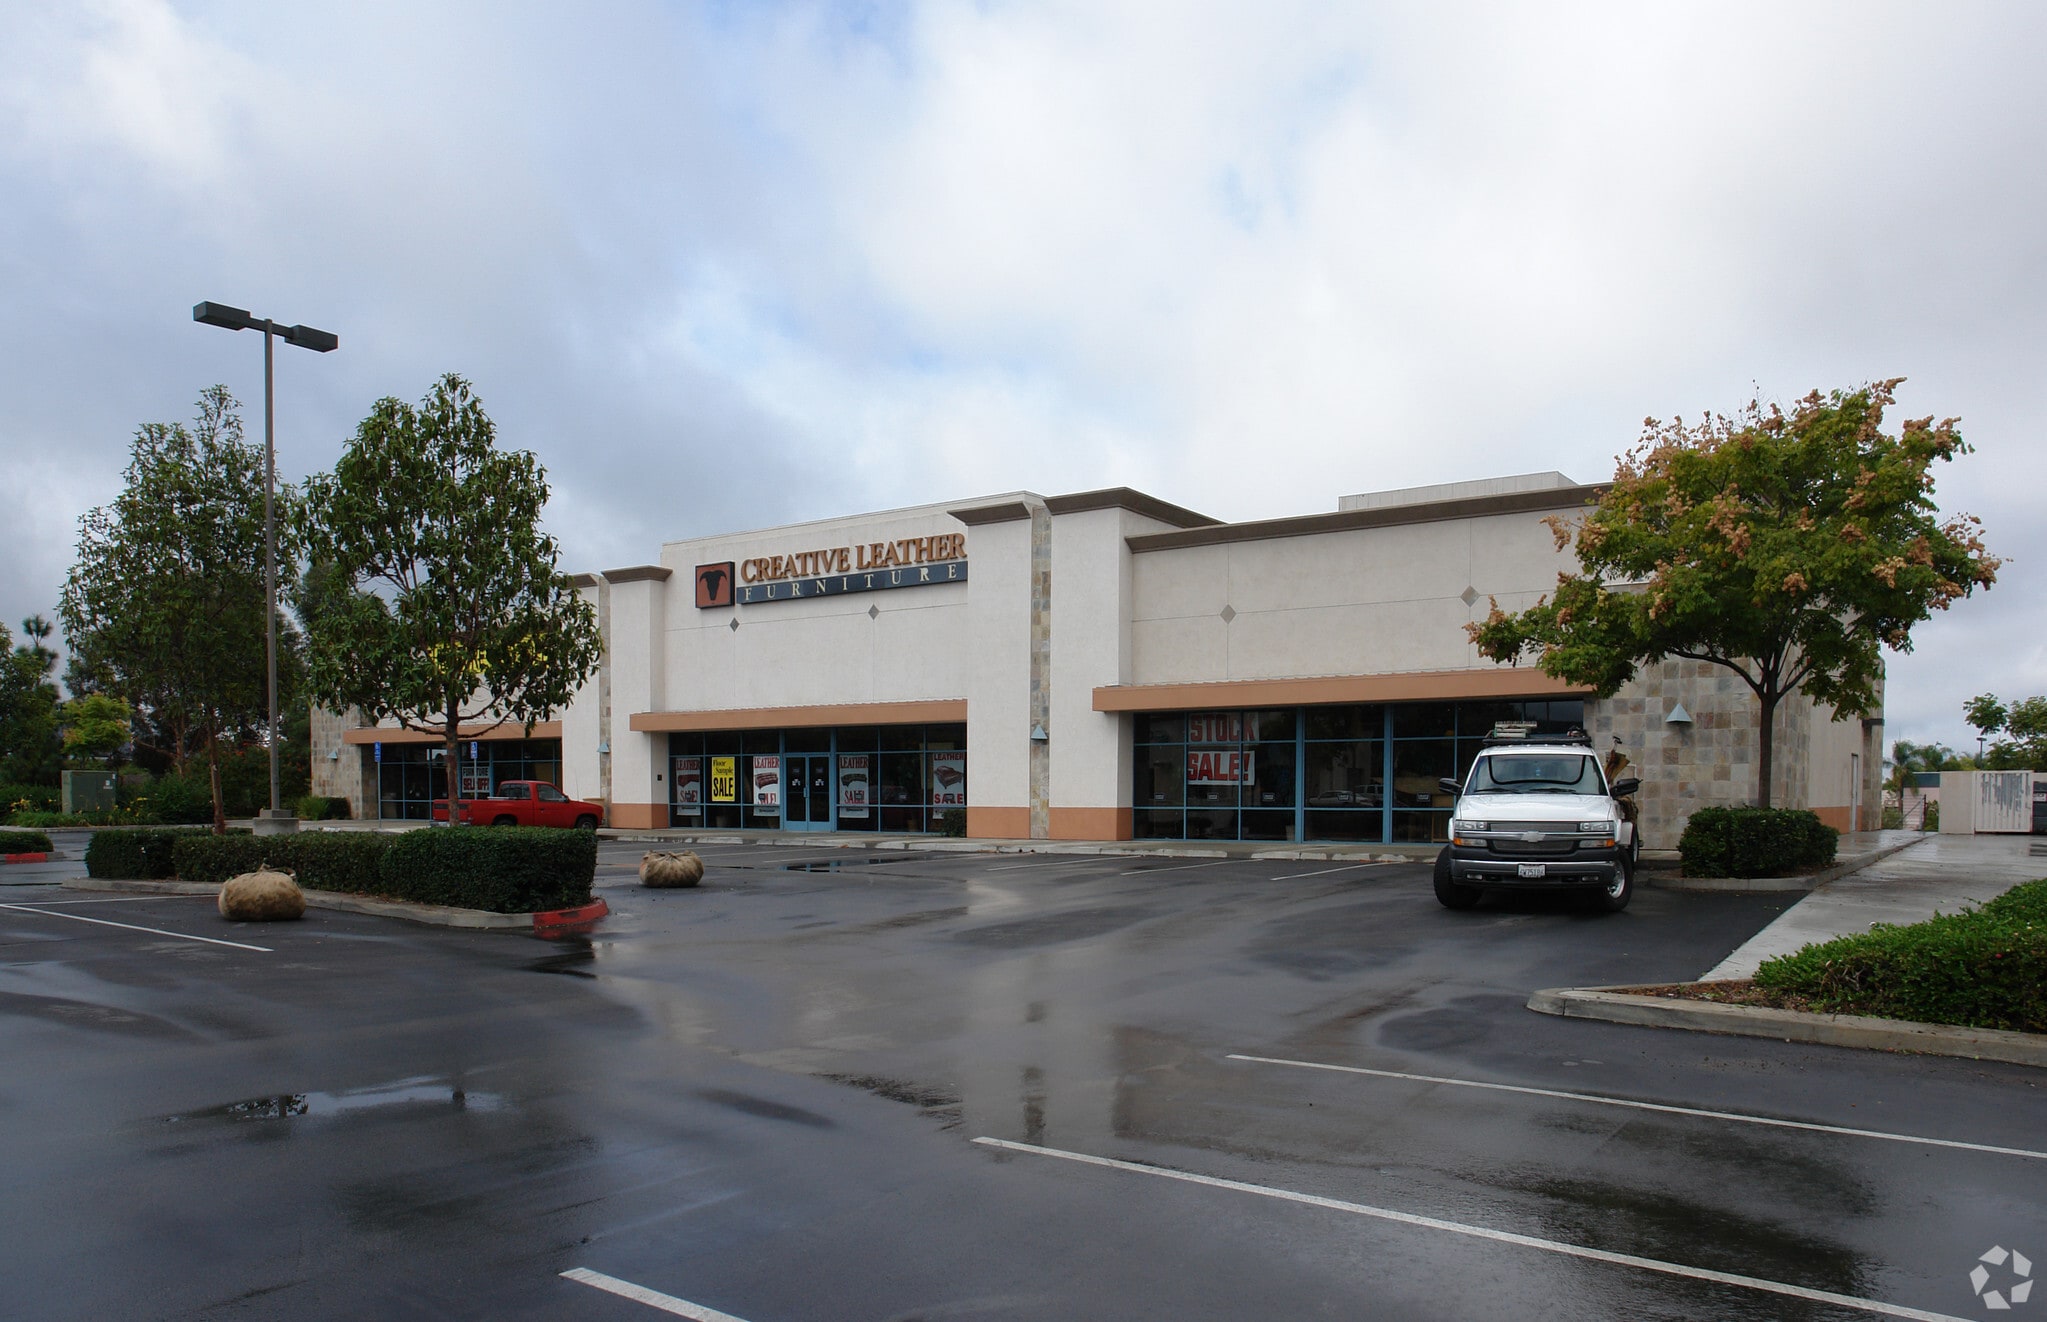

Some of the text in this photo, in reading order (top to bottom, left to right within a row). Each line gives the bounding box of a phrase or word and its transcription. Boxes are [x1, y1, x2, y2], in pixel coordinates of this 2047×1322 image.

[740, 532, 967, 584] CREATIVE LEATHER
[744, 563, 958, 601] FURNITURE
[1190, 713, 1255, 742] STOCK
[677, 759, 700, 770] LEATHER
[754, 757, 780, 769] LEATHER
[840, 756, 868, 769] LEATHER
[933, 751, 964, 761] LEATHER
[463, 767, 489, 777] FURNTURE
[1188, 752, 1251, 781] SALE!
[713, 777, 734, 798] SALE
